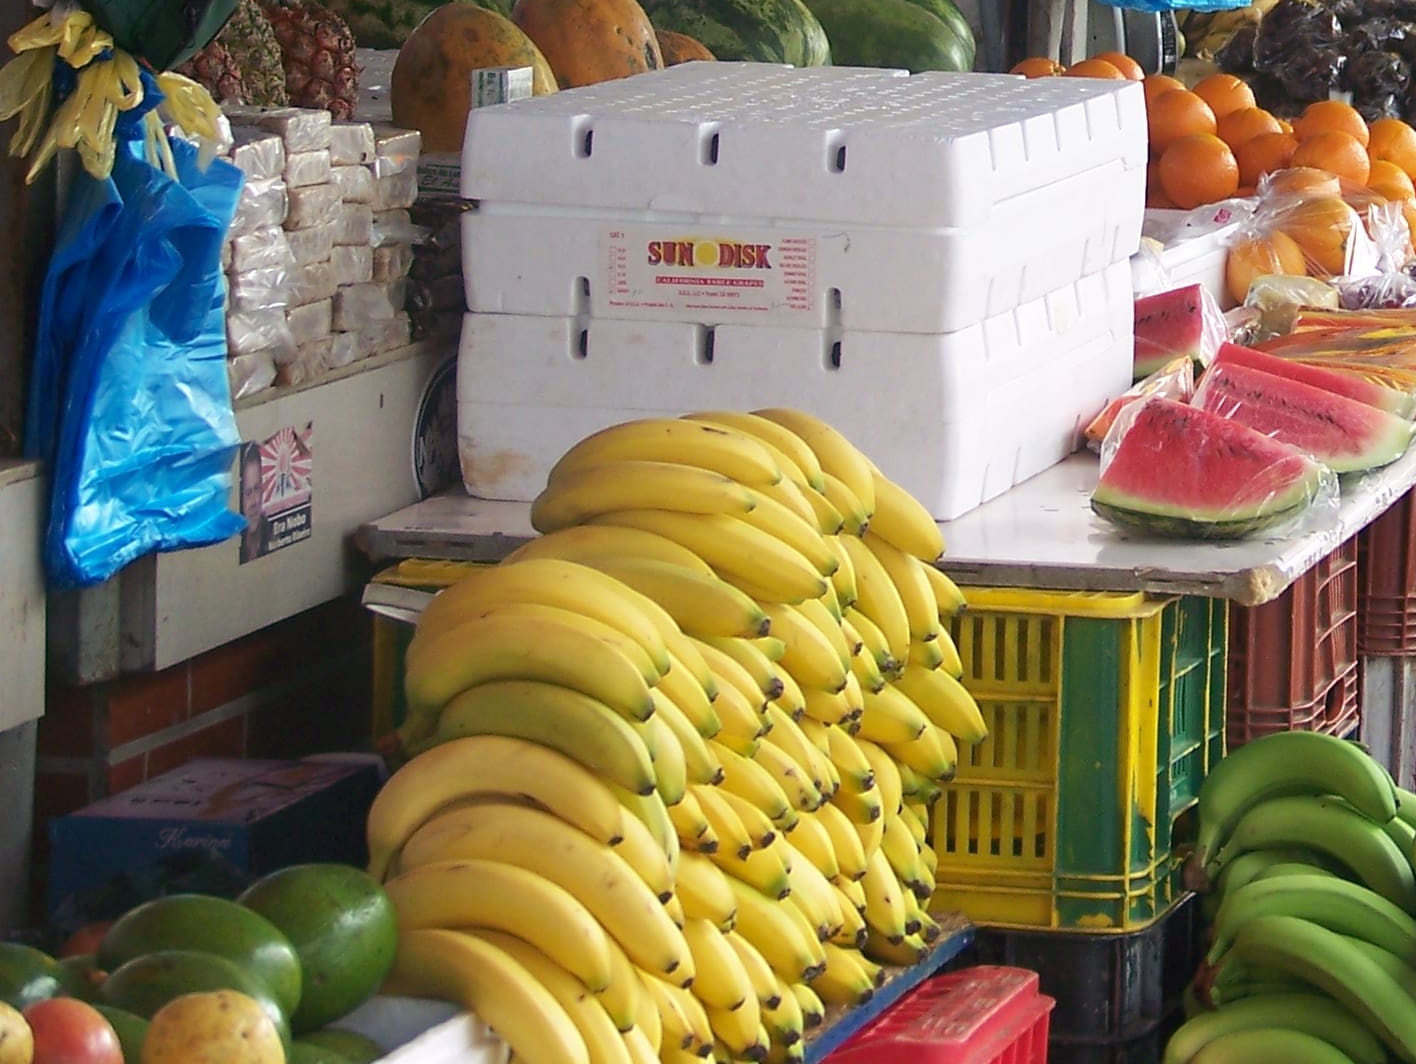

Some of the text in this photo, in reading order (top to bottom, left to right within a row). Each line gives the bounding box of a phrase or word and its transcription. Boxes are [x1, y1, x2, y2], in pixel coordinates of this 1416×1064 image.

[647, 240, 772, 269] SUN DISK
[656, 276, 705, 285] CALIFORNIA
